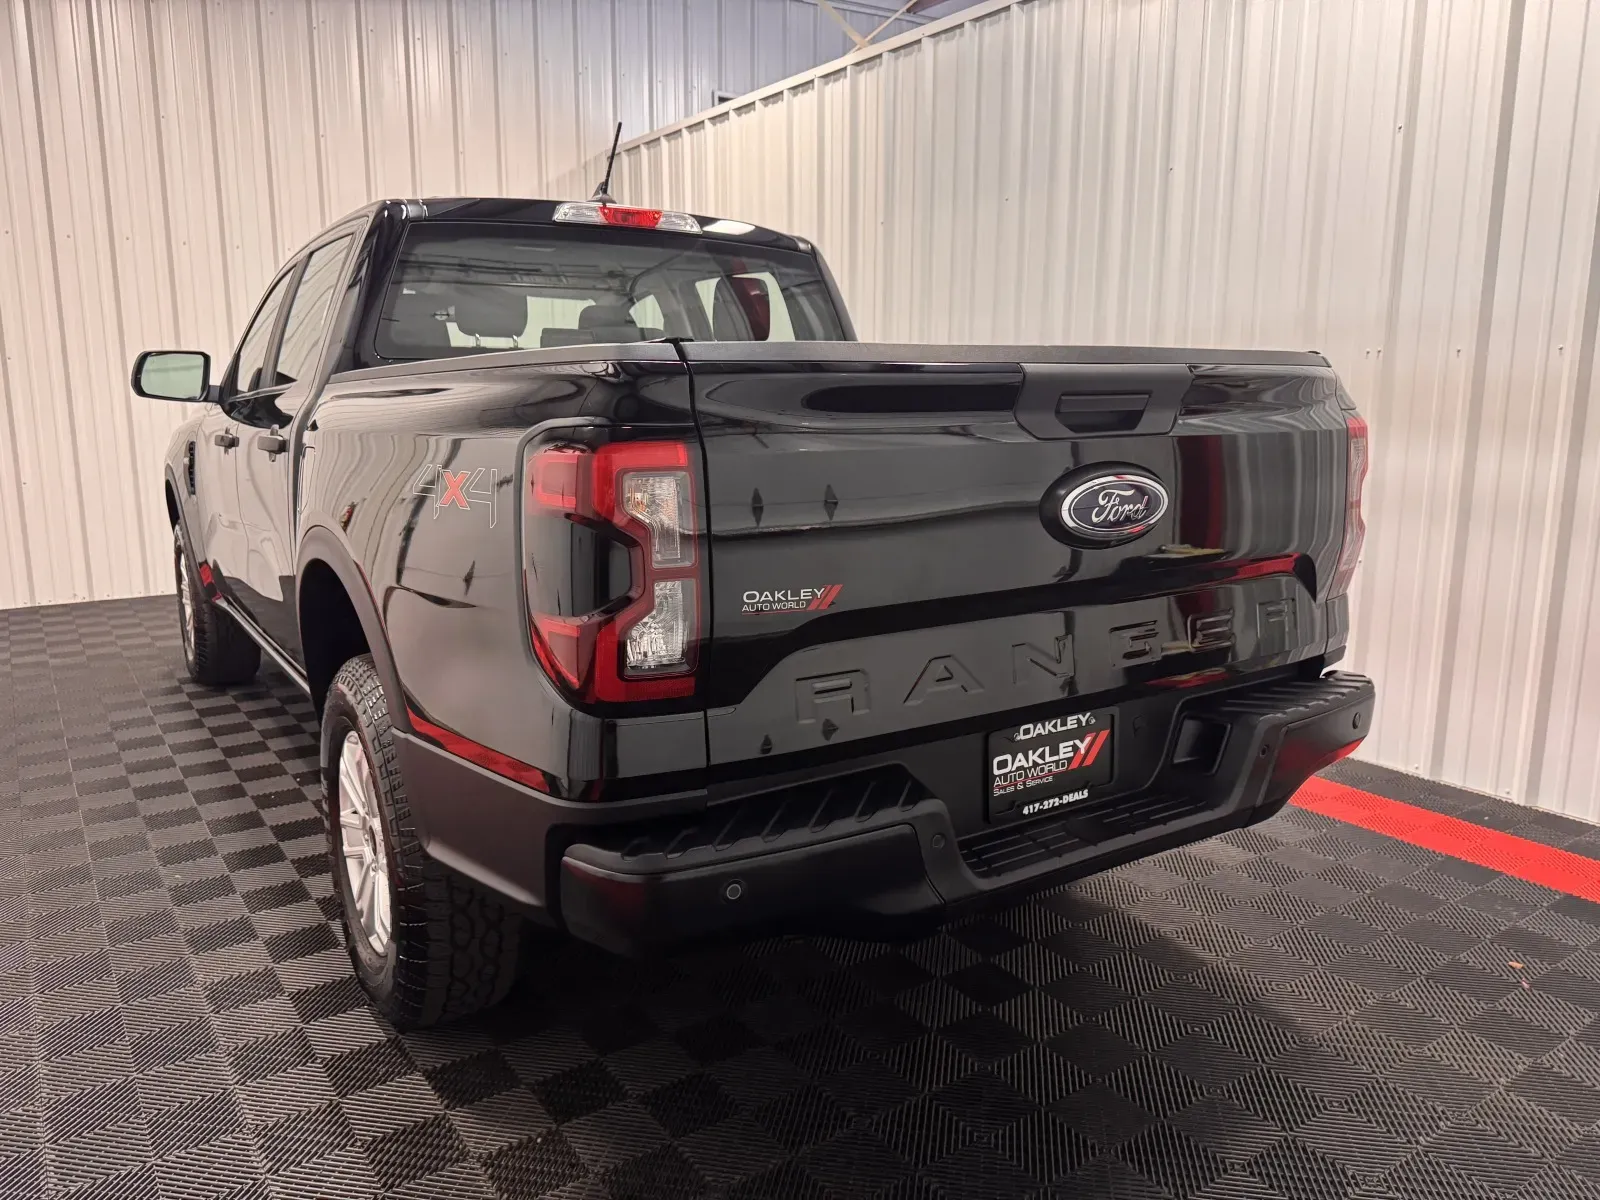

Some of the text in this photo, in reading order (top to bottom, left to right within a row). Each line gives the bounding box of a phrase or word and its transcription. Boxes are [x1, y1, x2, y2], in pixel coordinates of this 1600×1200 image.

[1091, 489, 1149, 523] Ford
[741, 600, 806, 612] AUTO WORLD
[742, 587, 825, 603] OAKLEY
[795, 596, 1299, 724] RANGER
[1019, 712, 1091, 740] OAKLEY
[992, 736, 1092, 776] OAKLEY
[993, 759, 1068, 788] AUTO WORLD
[1016, 781, 1024, 790] &
[1022, 789, 1089, 815] 417-272-DEALS
